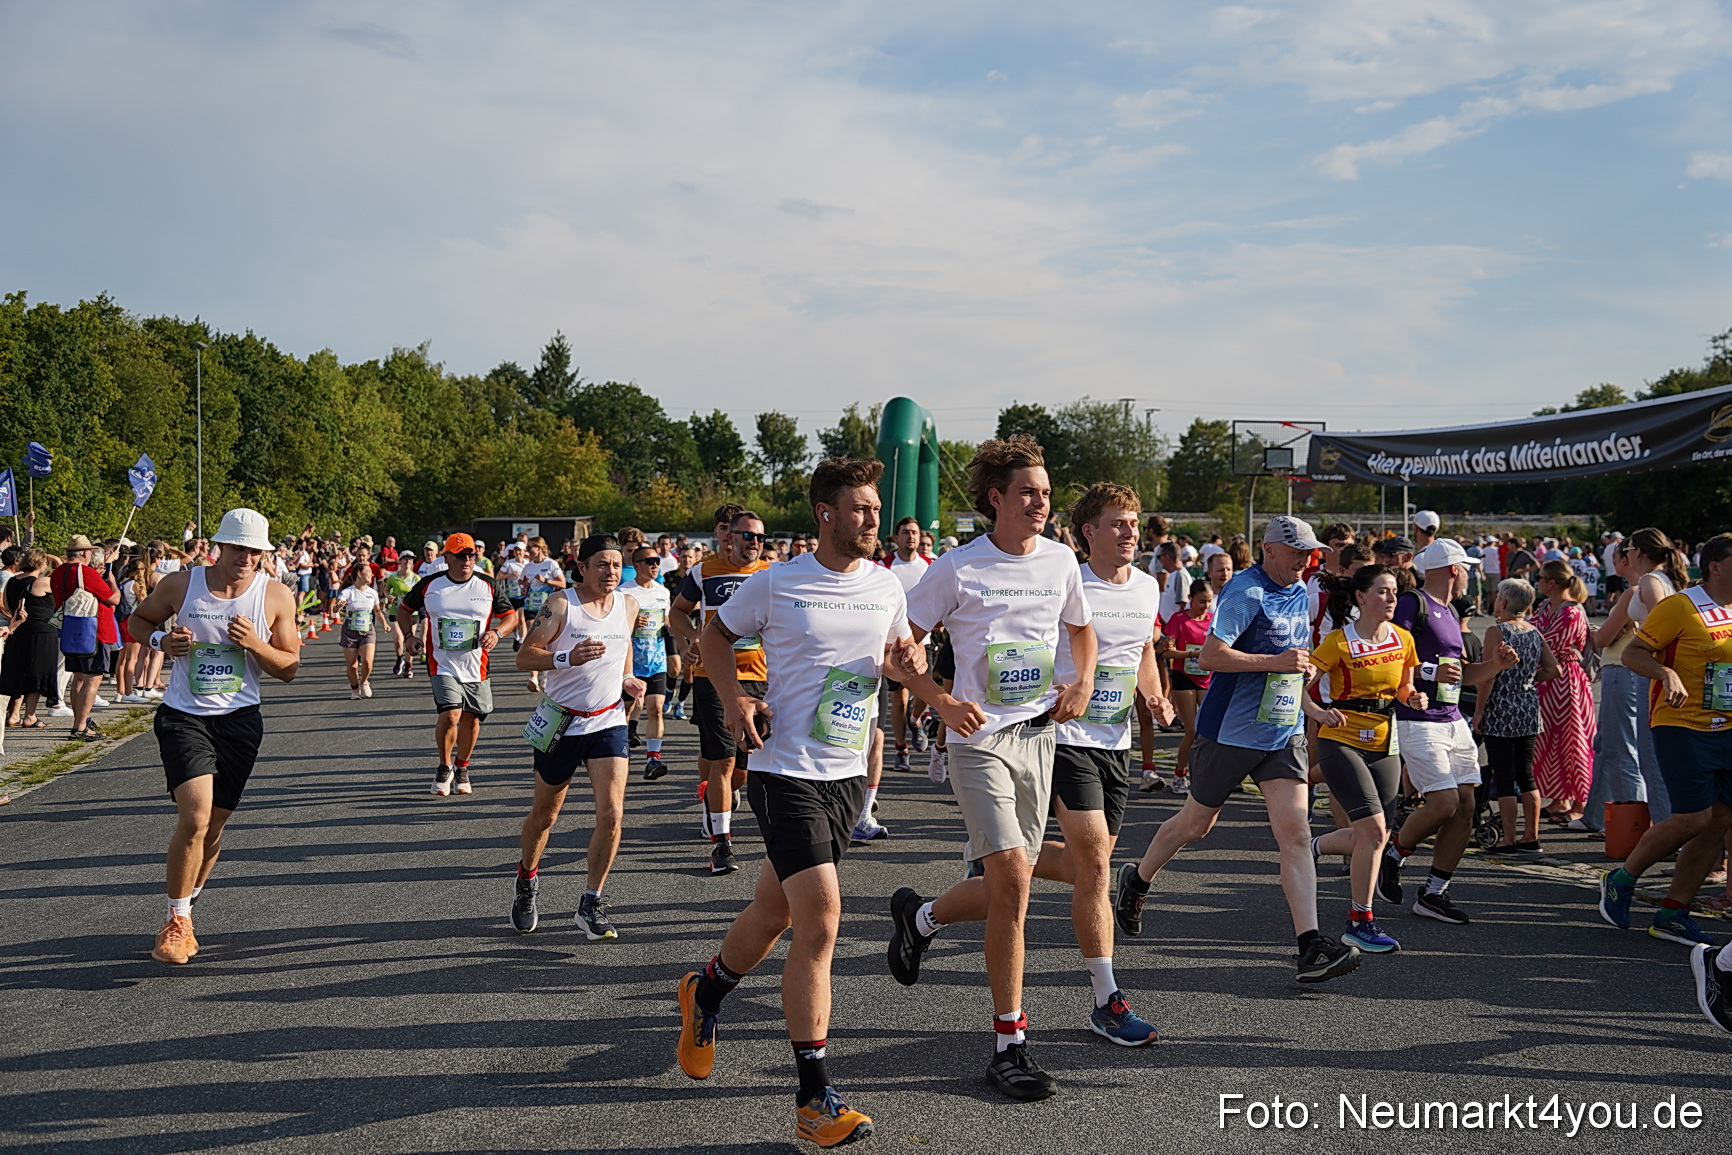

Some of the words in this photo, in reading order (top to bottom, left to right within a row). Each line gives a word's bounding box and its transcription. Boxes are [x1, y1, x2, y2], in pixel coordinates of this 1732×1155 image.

[1367, 450, 1401, 475] Hier
[1400, 448, 1471, 482] gewinnt
[1471, 446, 1508, 474] das
[1508, 431, 1651, 472] Miteinander.
[1584, 572, 1596, 584] 26
[980, 589, 1024, 597] RUPPRECHT
[1029, 589, 1062, 597] HOLZBAU
[793, 601, 846, 610] RUPPRECHT
[853, 603, 889, 612] HOLZBAU
[188, 612, 224, 621] RUPPRECHT
[1091, 611, 1121, 619] PPRECHT
[449, 631, 464, 639] 125
[1709, 628, 1732, 642] MAX
[1352, 657, 1381, 669] MAX
[197, 663, 234, 676] 2390
[999, 667, 1041, 683] 2388
[1090, 689, 1123, 703] 2391
[1275, 694, 1295, 706] 794
[830, 701, 866, 723] 2393
[530, 711, 549, 729] 387
